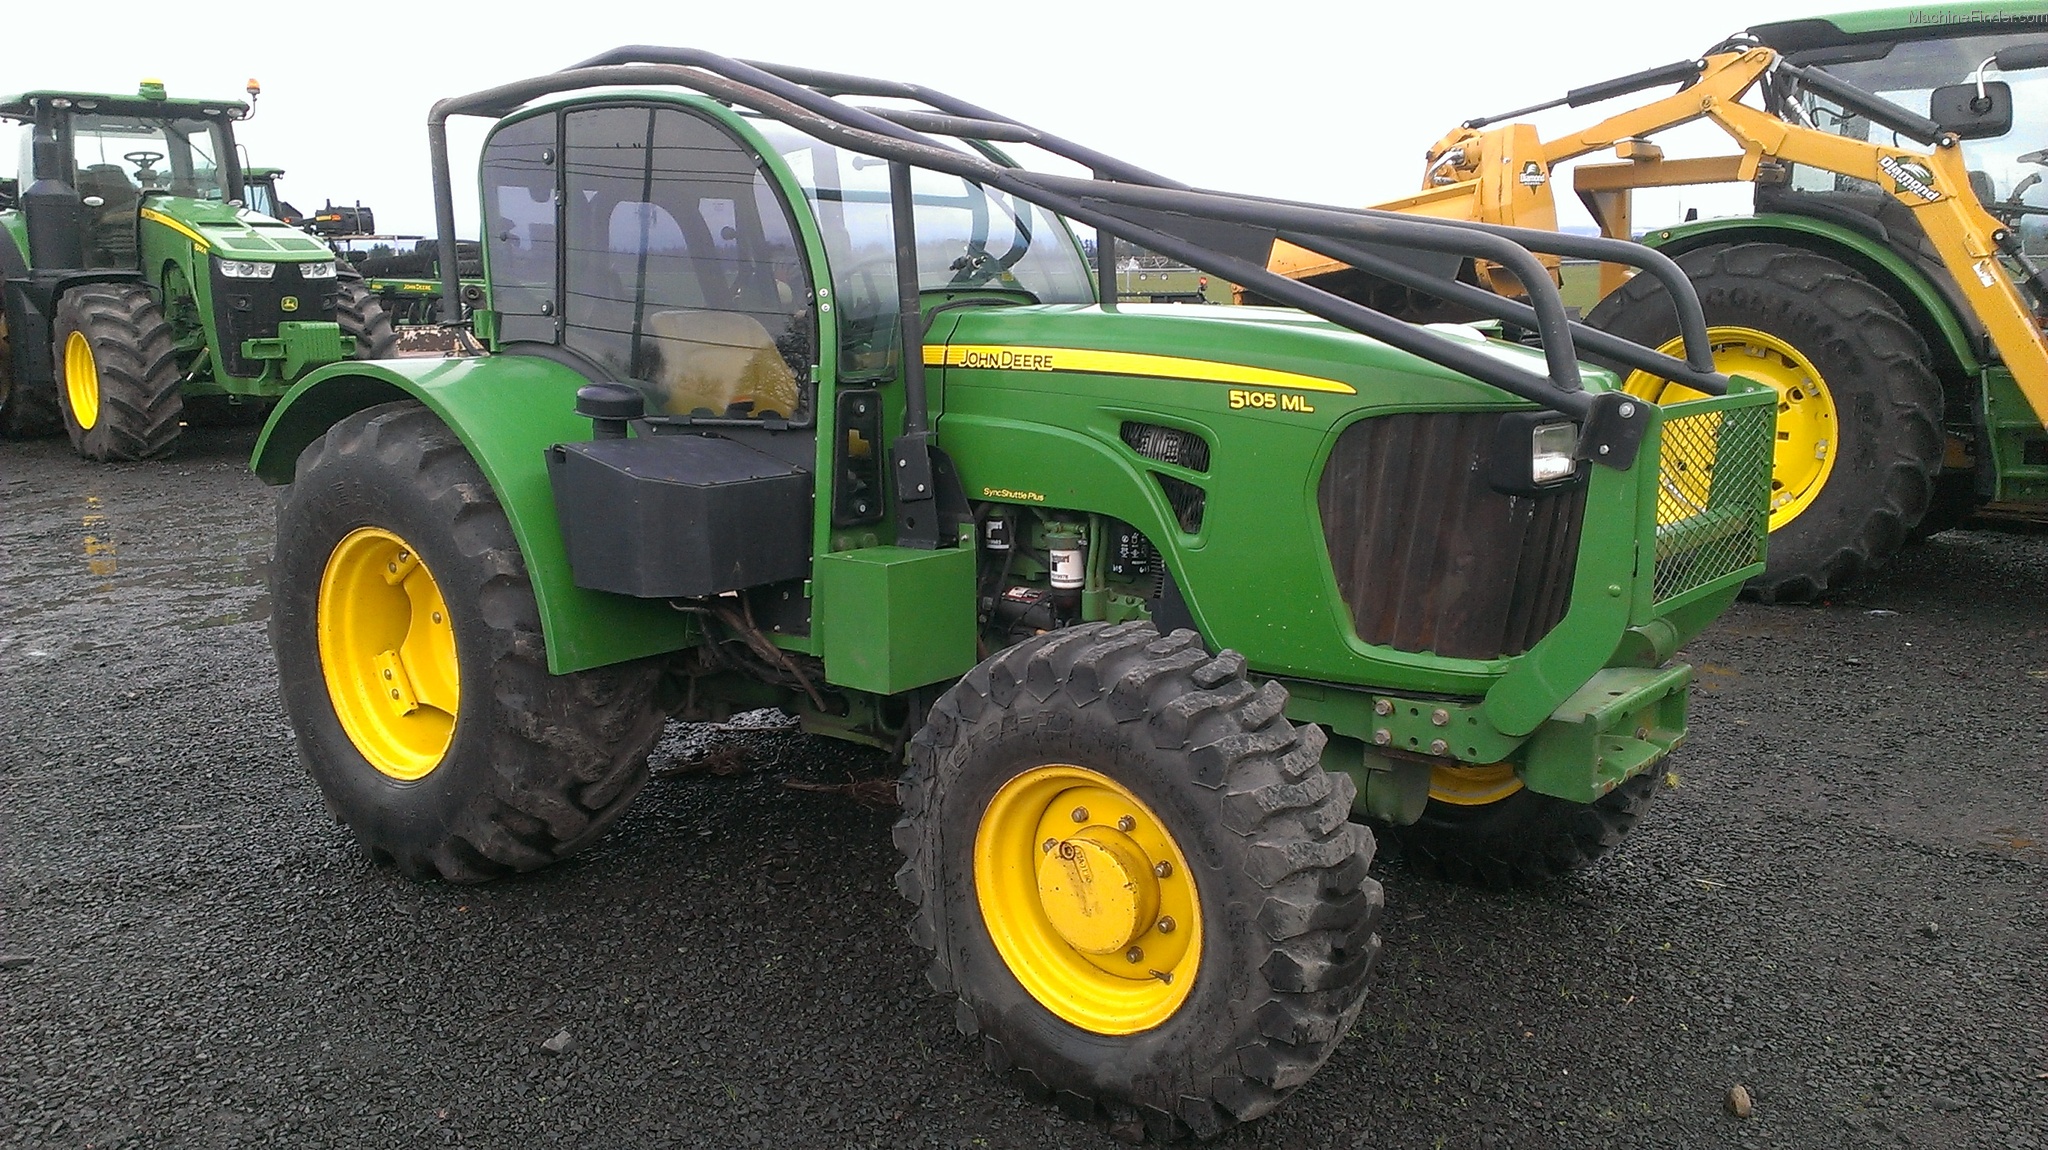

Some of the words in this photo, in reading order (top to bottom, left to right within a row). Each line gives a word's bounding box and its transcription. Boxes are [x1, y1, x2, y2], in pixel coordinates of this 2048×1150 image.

[960, 349, 999, 367] JOHN
[1001, 350, 1053, 369] DEERE
[1229, 389, 1277, 409] 5105
[1281, 394, 1314, 413] ML
[983, 487, 1027, 500] SyncShuttle
[1027, 491, 1044, 502] Plus
